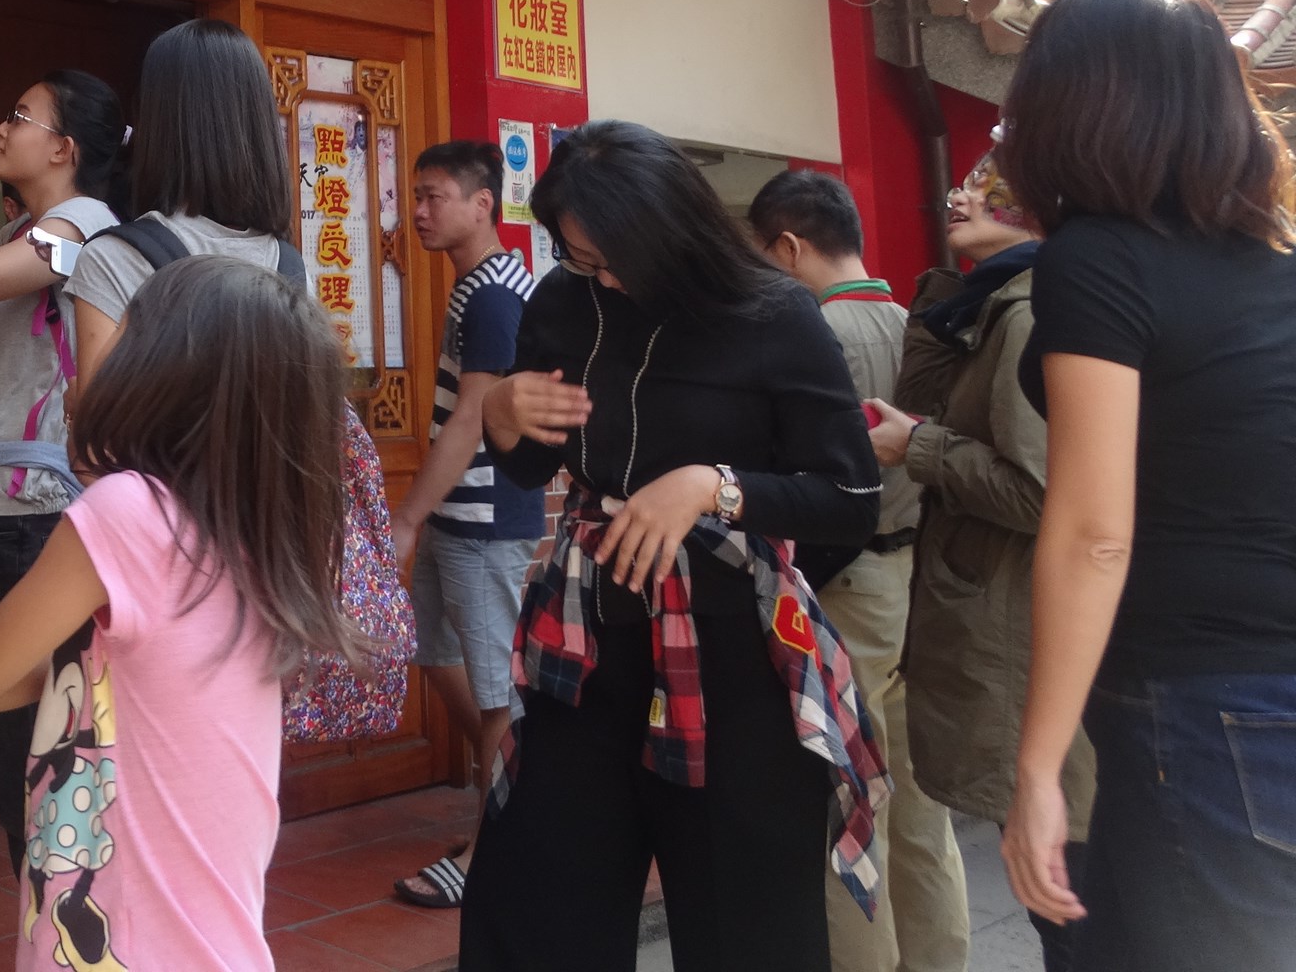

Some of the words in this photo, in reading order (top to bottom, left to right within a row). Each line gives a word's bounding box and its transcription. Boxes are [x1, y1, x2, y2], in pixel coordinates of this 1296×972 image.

[503, 32, 576, 80] 在紅色鐵皮屋內
